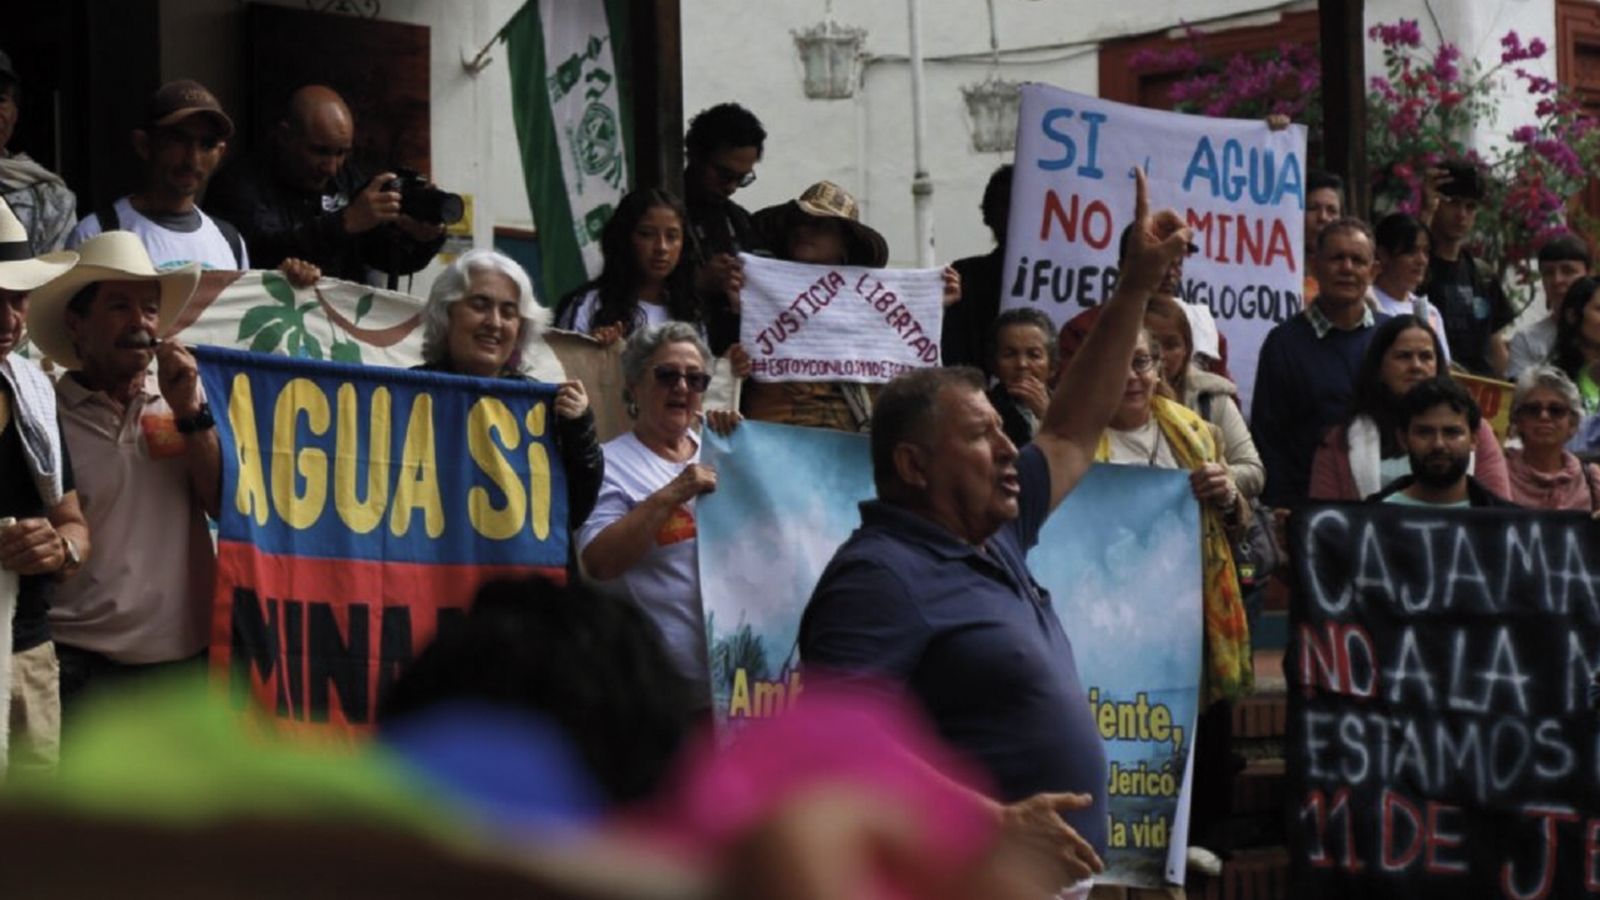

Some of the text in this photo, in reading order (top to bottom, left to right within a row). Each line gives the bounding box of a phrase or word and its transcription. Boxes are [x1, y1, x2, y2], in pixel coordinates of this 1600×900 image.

[1037, 107, 1108, 180] SI
[1182, 135, 1304, 211] AGUA
[1040, 189, 1297, 273] NO MINA
[756, 270, 846, 356] JUSTICIA
[1175, 277, 1302, 324] NGLOGOLD
[227, 372, 446, 540] AGUA
[1300, 620, 1377, 697] NO
[1383, 626, 1435, 703] A
[1449, 626, 1531, 714] LA
[1304, 711, 1576, 803] ESTAMOS
[1132, 814, 1172, 849] vid
[1300, 788, 1365, 873] 11
[1380, 788, 1468, 873] DE
